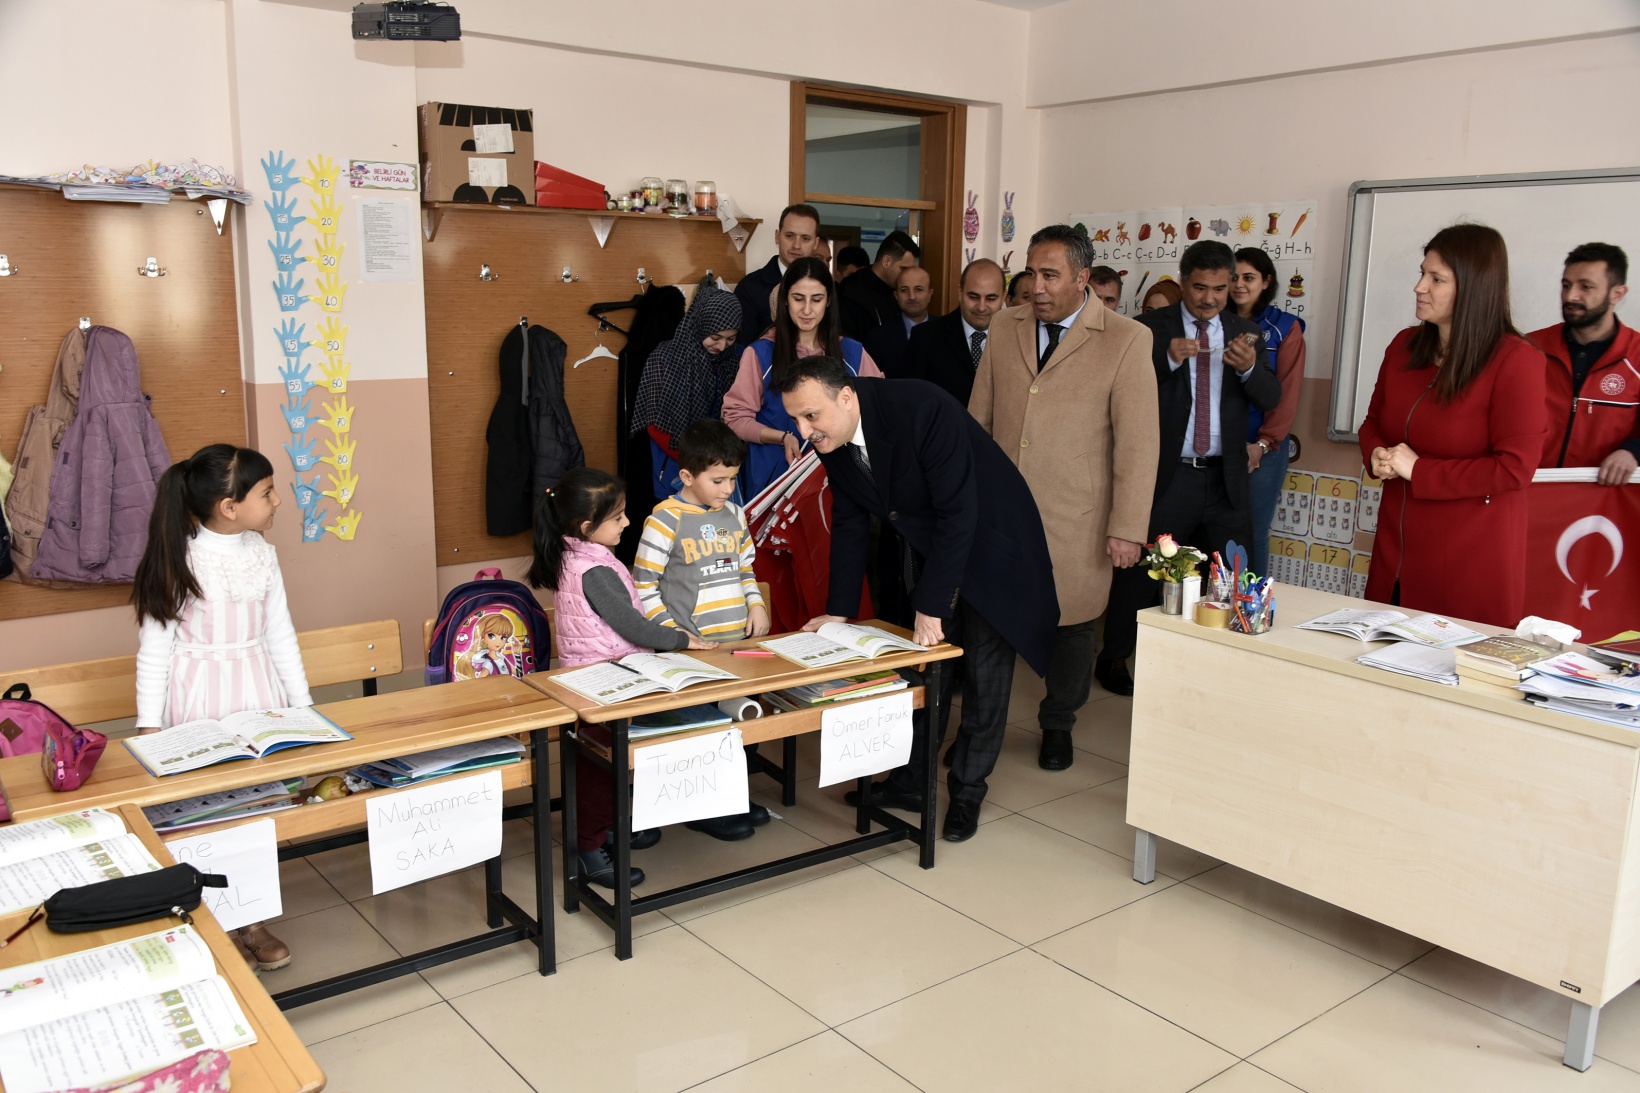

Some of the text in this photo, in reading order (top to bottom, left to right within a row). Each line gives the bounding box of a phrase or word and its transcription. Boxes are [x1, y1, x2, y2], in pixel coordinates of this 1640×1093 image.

[393, 168, 407, 176] GÜN
[273, 174, 282, 184] 5
[319, 178, 330, 189] 10
[277, 214, 288, 223] 15
[321, 217, 332, 226] 20
[1112, 248, 1132, 260] C-c
[1135, 247, 1153, 261] Ç-ç
[1156, 246, 1177, 259] D-d
[279, 255, 291, 265] 25
[321, 254, 336, 267] 30
[283, 295, 295, 306] 35
[324, 296, 338, 307] 40
[1285, 299, 1305, 317] P-p
[326, 340, 340, 352] 50
[289, 380, 301, 391] 55
[331, 377, 343, 389] 60
[292, 416, 305, 428] 65
[337, 454, 349, 465] 80
[1289, 475, 1298, 491] 5
[1331, 482, 1341, 497] 6
[681, 530, 742, 565] RUGBY
[1278, 540, 1295, 557] 16
[1321, 548, 1338, 565] 17
[877, 703, 909, 728] Faruk
[839, 732, 896, 761] ALVER
[646, 750, 716, 776] Tuana
[654, 770, 717, 806] AYDIN
[378, 782, 493, 828] Muhammet
[411, 818, 442, 840] Ali
[171, 842, 213, 863] ne
[396, 837, 455, 871] SAKA
